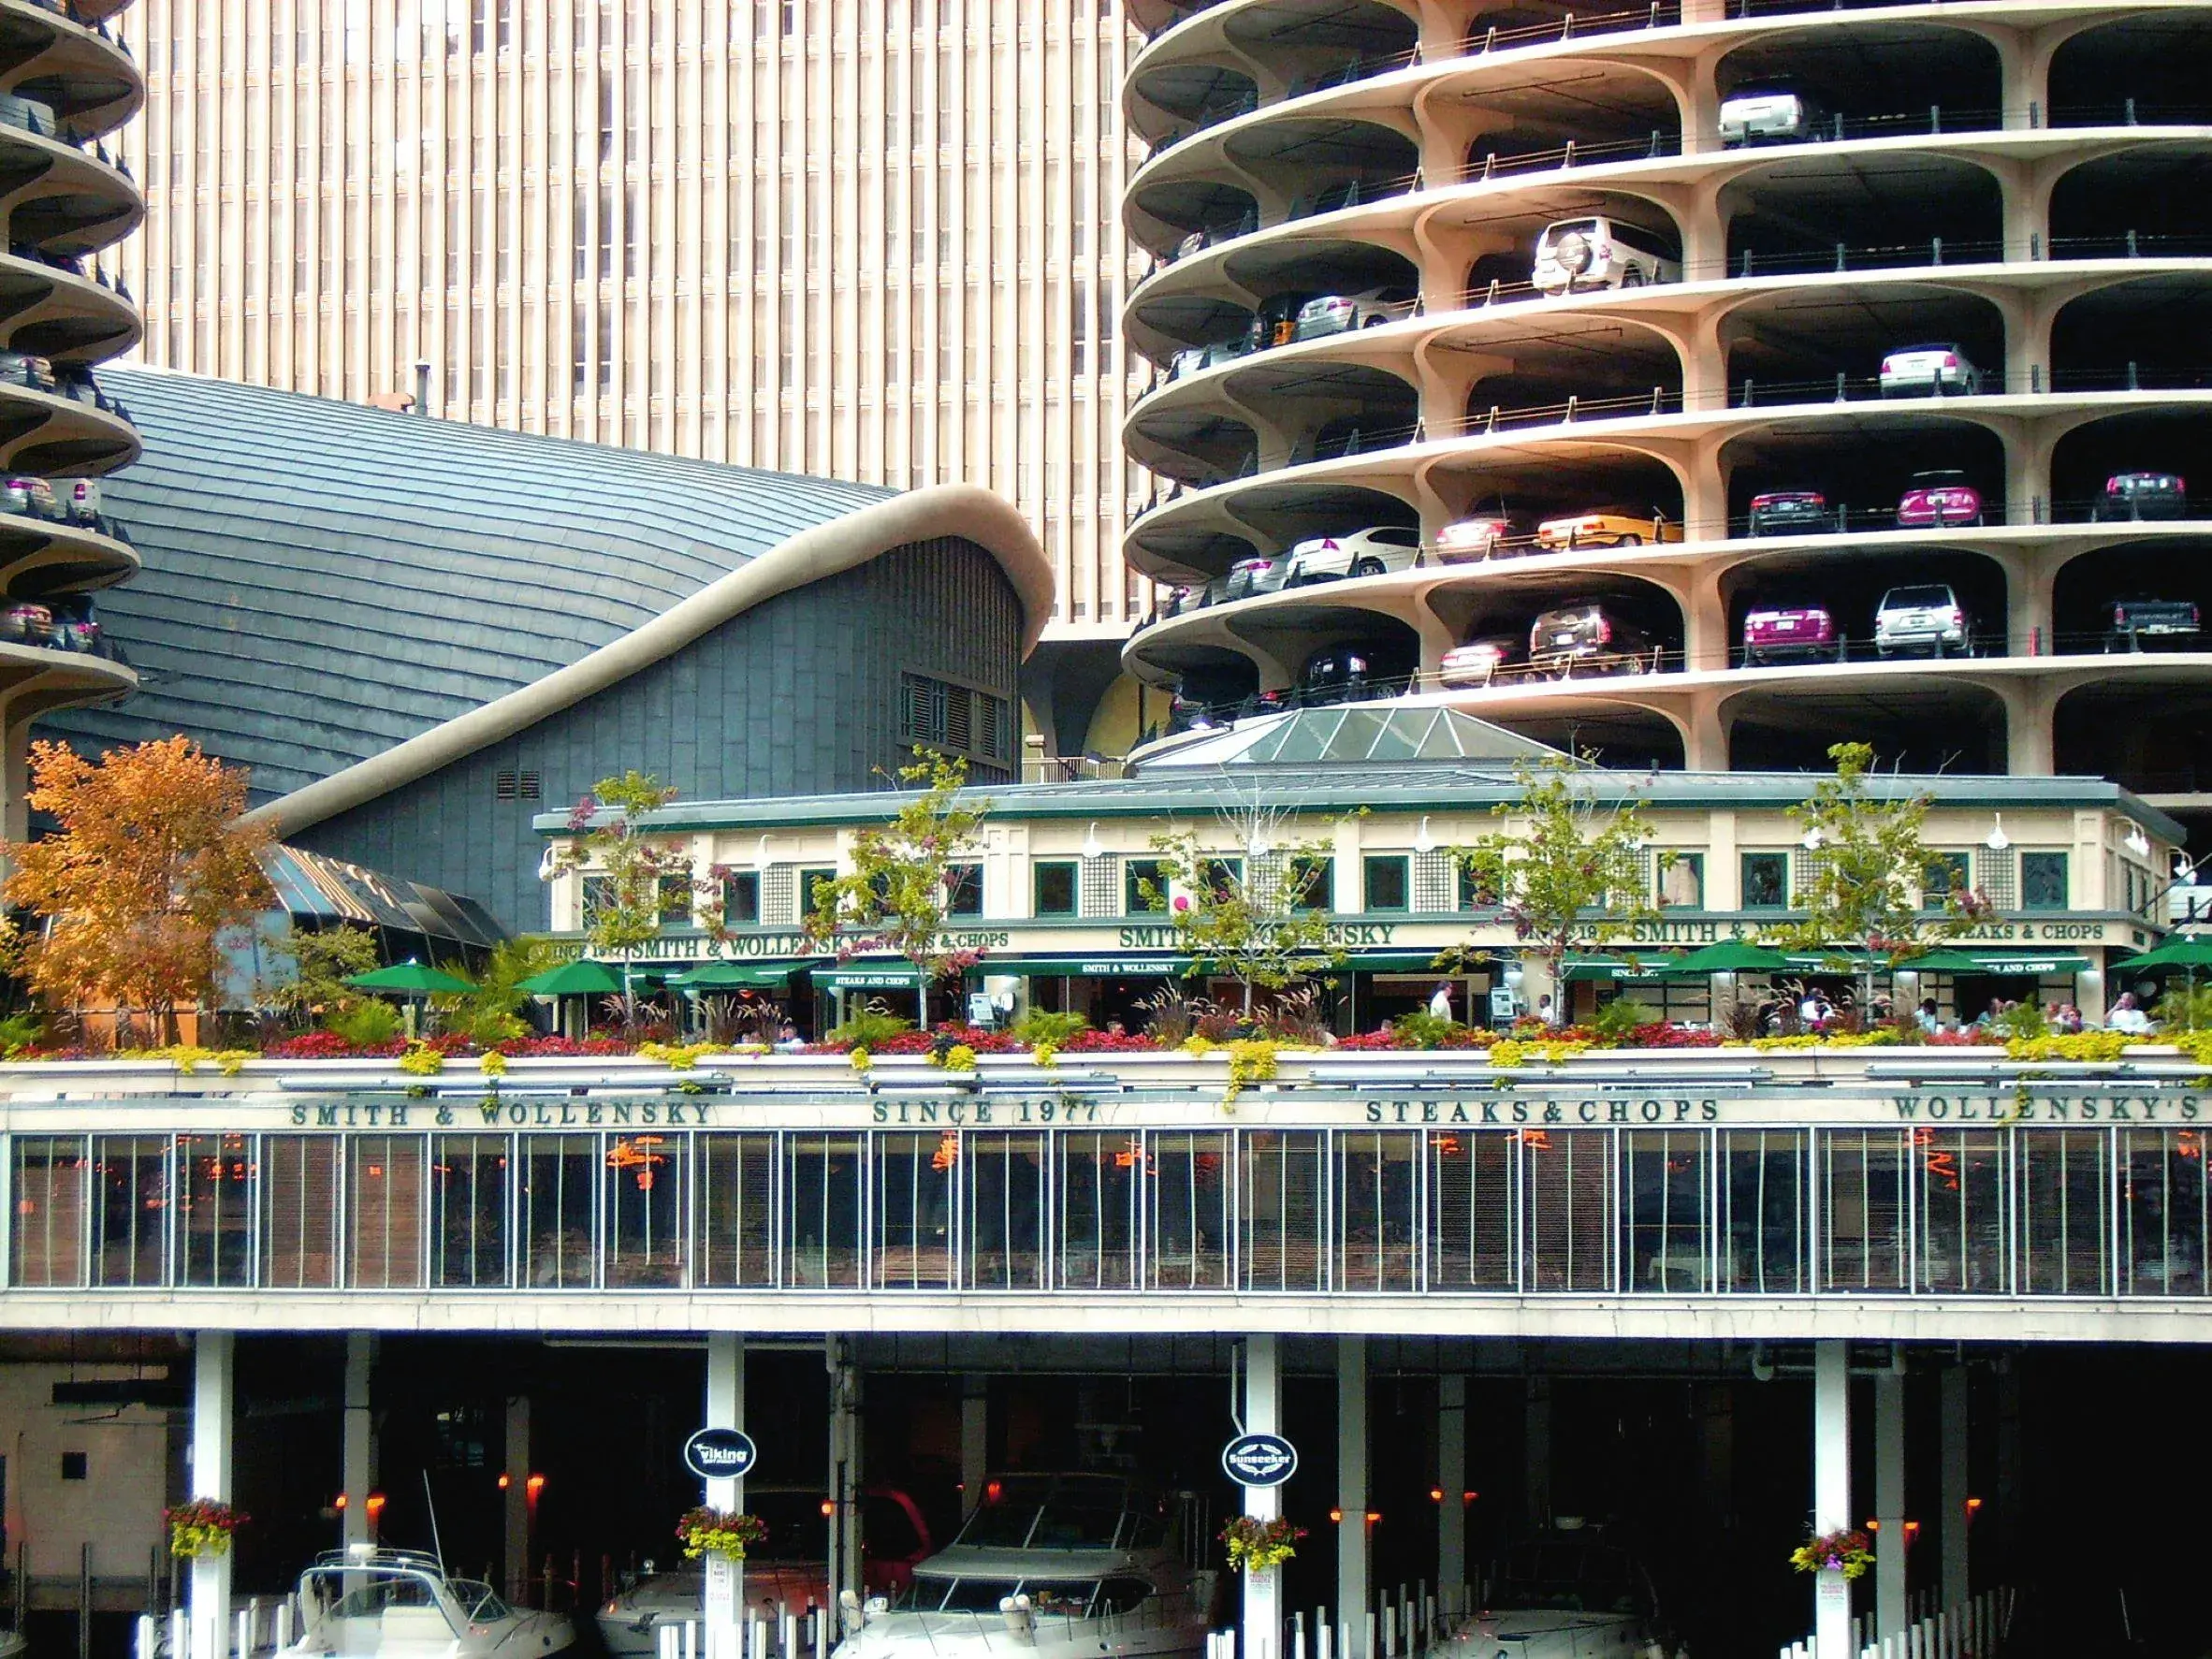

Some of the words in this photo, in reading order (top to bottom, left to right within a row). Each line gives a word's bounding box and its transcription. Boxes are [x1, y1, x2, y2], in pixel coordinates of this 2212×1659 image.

[940, 933, 953, 948] &
[956, 932, 1009, 948] CHOPS
[1633, 921, 1716, 942] SMITH
[2023, 924, 2034, 939] &
[2043, 924, 2103, 939] CHOPS
[632, 939, 699, 958] SMITH
[706, 939, 721, 956] &
[1083, 964, 1110, 973] SMITH
[1122, 964, 1175, 973] WOLLENSKY
[291, 1103, 407, 1125] SMITH
[435, 1104, 454, 1123] &
[482, 1102, 711, 1125] WOLLENSKY
[873, 1100, 992, 1123] SINCE
[1020, 1099, 1099, 1122] 1977
[1895, 1097, 2199, 1119] WOLLENSKY'S
[1230, 1454, 1290, 1464] Sunseeker
